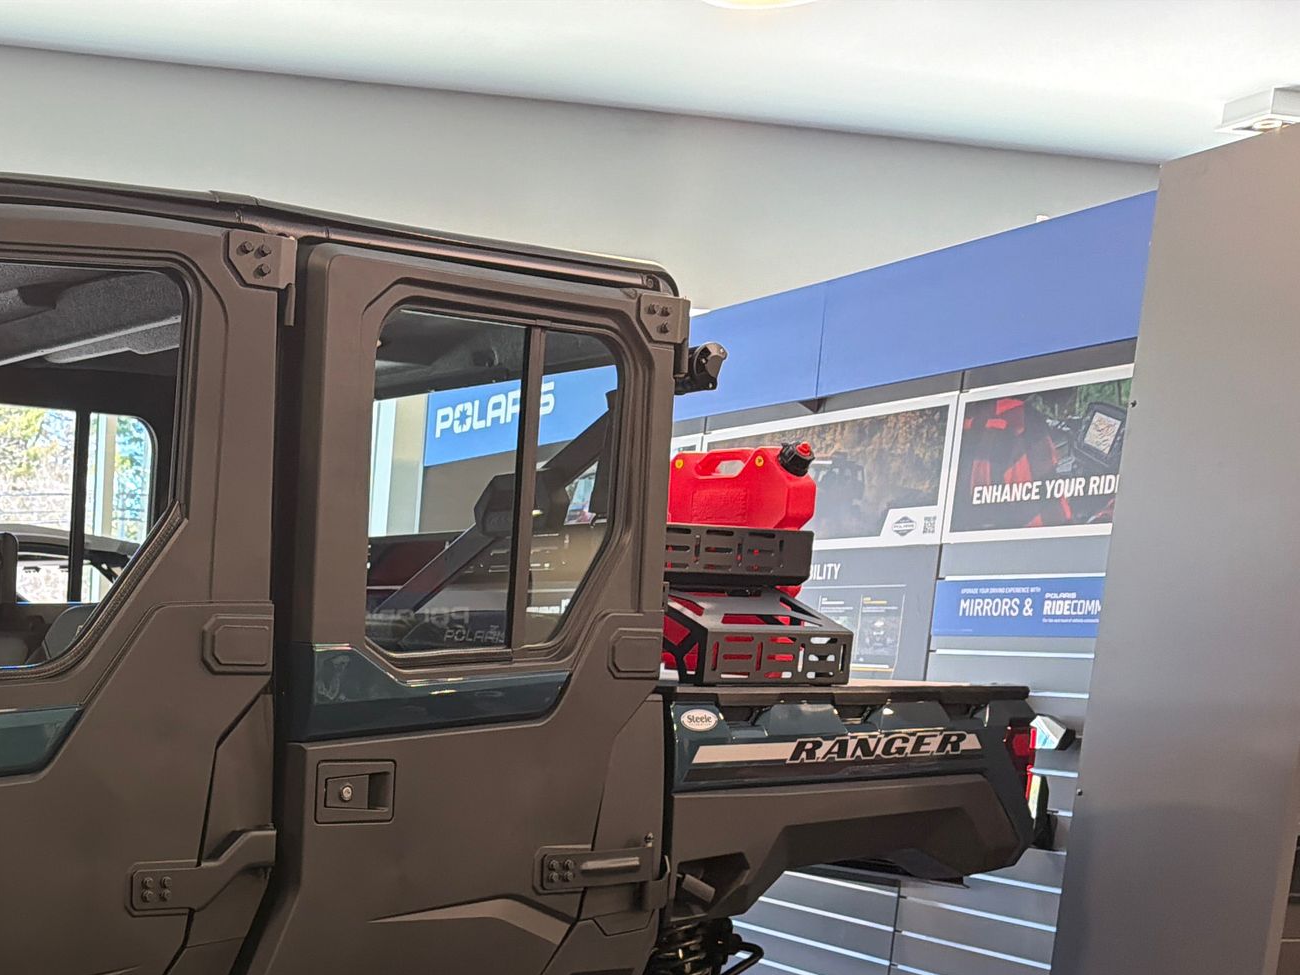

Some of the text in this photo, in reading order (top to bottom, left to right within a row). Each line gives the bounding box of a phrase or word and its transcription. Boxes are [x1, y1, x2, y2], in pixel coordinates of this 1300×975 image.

[435, 381, 555, 438] POLARS
[972, 481, 1042, 505] ENHANCE
[1045, 477, 1086, 499] YOUR
[958, 598, 1020, 617] MIRRORS
[1022, 598, 1033, 616] &
[687, 714, 712, 724] Steele
[786, 731, 968, 764] RANGER
